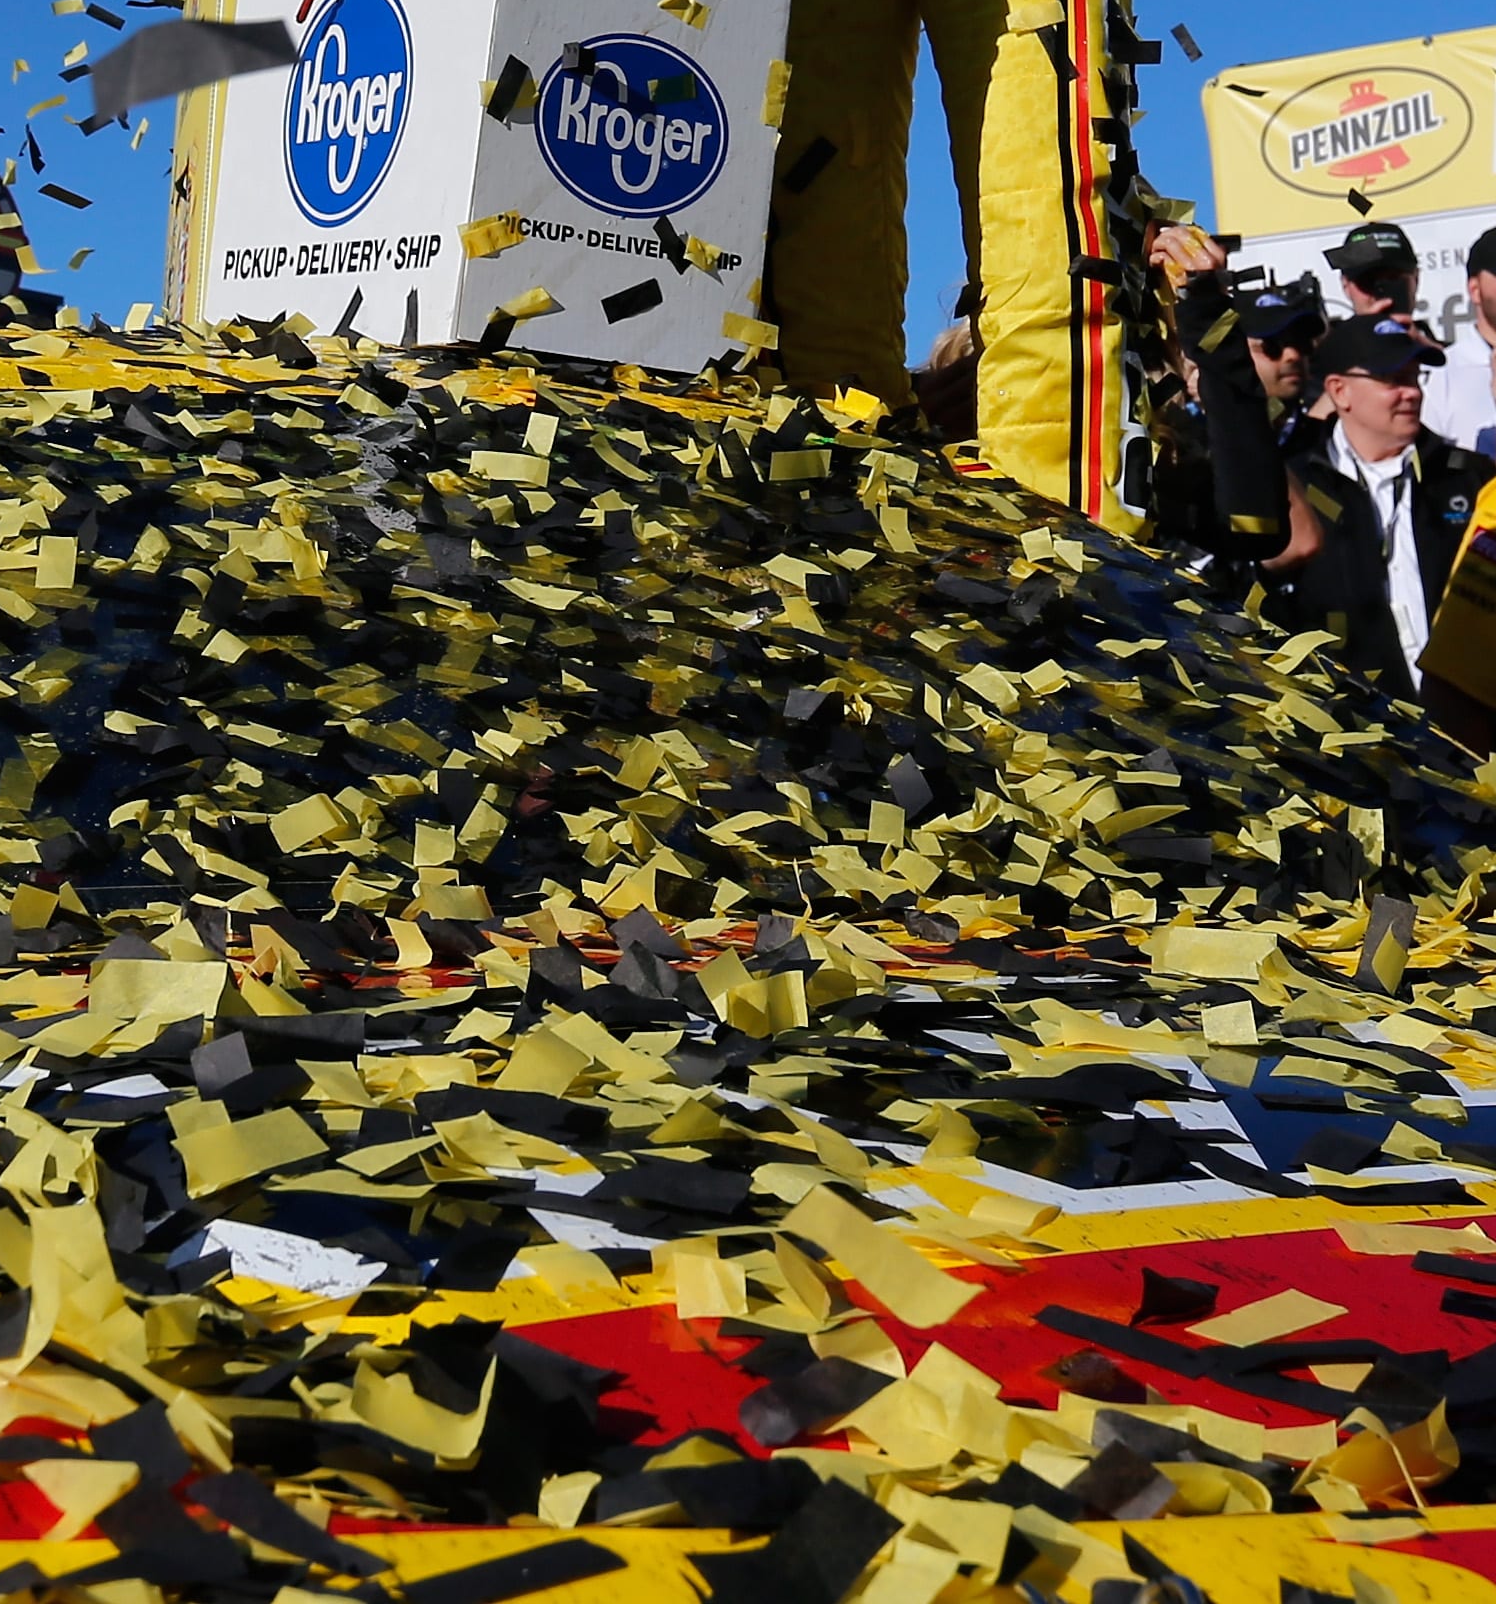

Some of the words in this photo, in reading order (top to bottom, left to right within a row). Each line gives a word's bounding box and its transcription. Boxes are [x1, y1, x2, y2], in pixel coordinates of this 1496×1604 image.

[296, 24, 402, 194] Kroger
[557, 61, 712, 194] Kroger
[1292, 93, 1438, 170] PENNZOIL
[223, 247, 288, 281] PICKUP
[296, 238, 387, 277] DELIVERY
[394, 234, 442, 270] SHIP
[587, 230, 669, 260] DELIVE
